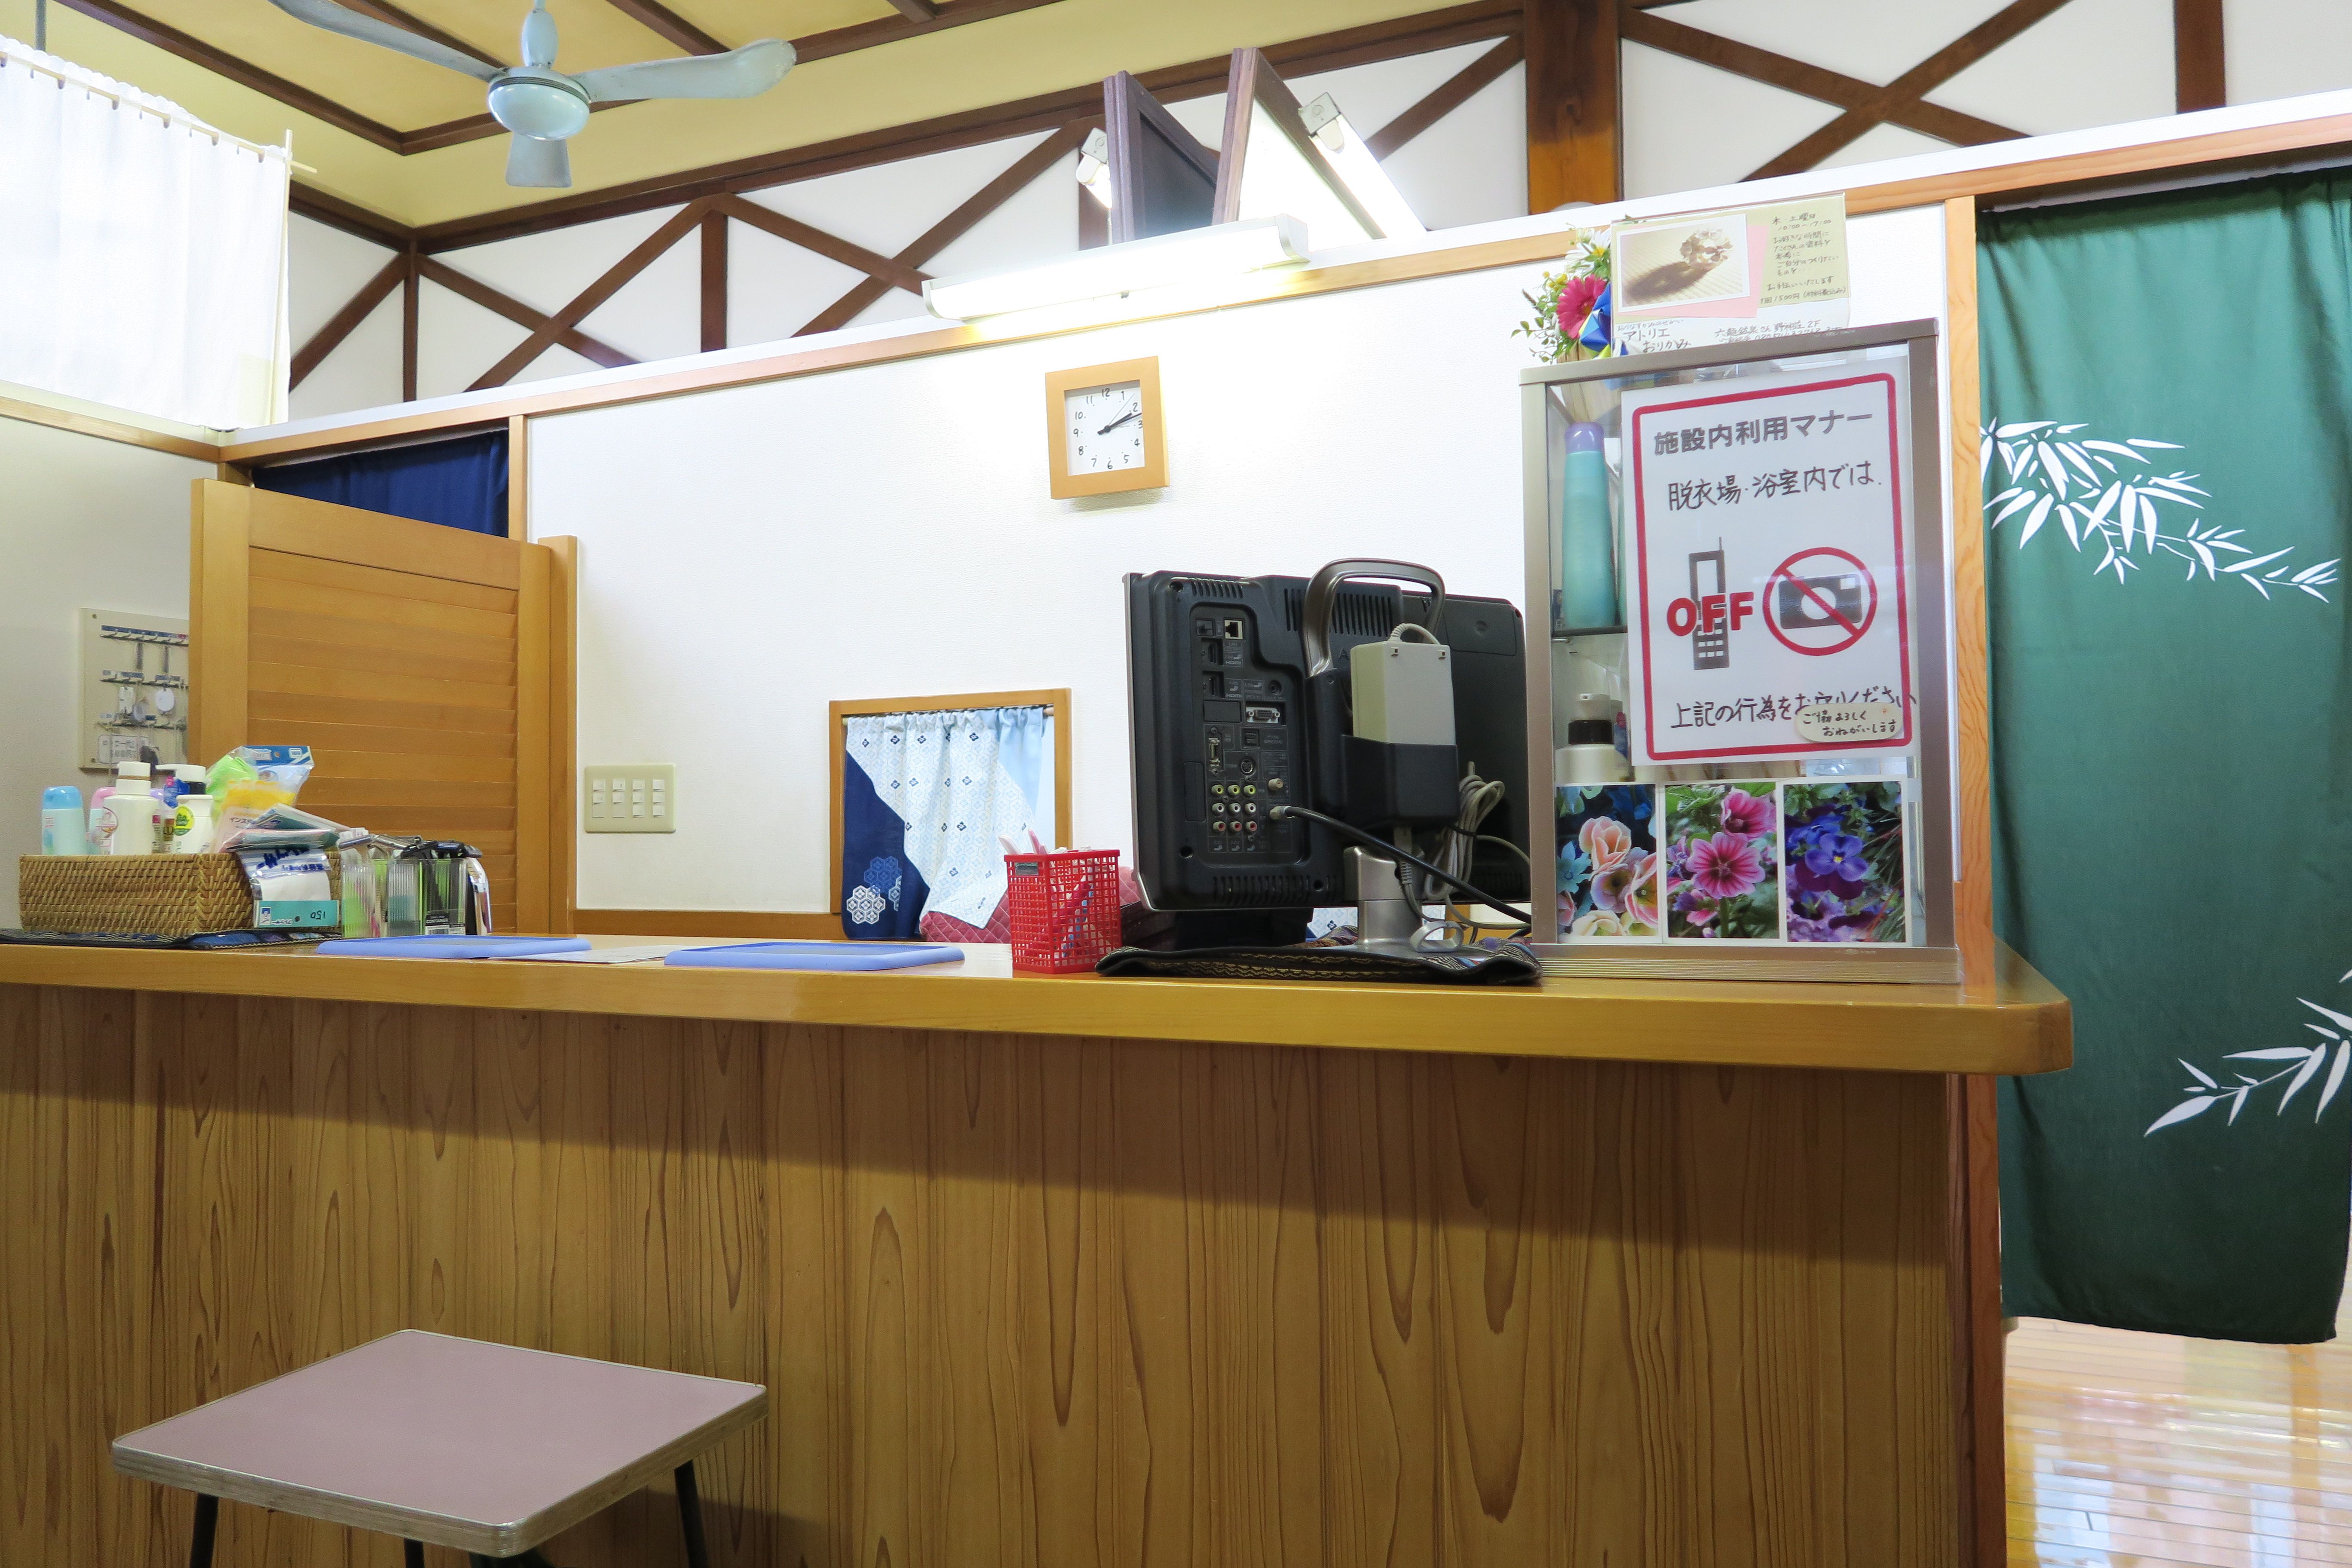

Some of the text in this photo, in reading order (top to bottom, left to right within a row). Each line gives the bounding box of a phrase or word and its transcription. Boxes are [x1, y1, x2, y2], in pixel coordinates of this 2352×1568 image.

[1623, 328, 1670, 342] アトリエ
[1102, 388, 1110, 397] 12
[1121, 391, 1125, 400] 1
[1086, 395, 1093, 404] 11
[1133, 402, 1138, 412] 2
[1075, 411, 1083, 420] 10
[1138, 420, 1143, 429] 3
[1073, 429, 1079, 438] 9
[1654, 410, 1873, 456] 施設内利用マナー
[1134, 438, 1140, 447] 4
[1078, 446, 1084, 455] 8
[1091, 458, 1097, 467] 7
[1124, 454, 1130, 464] 5
[1107, 460, 1113, 469] 6
[1666, 591, 1755, 637] OFF
[1822, 719, 1896, 736] おねがいします
[310, 910, 327, 920] 150
